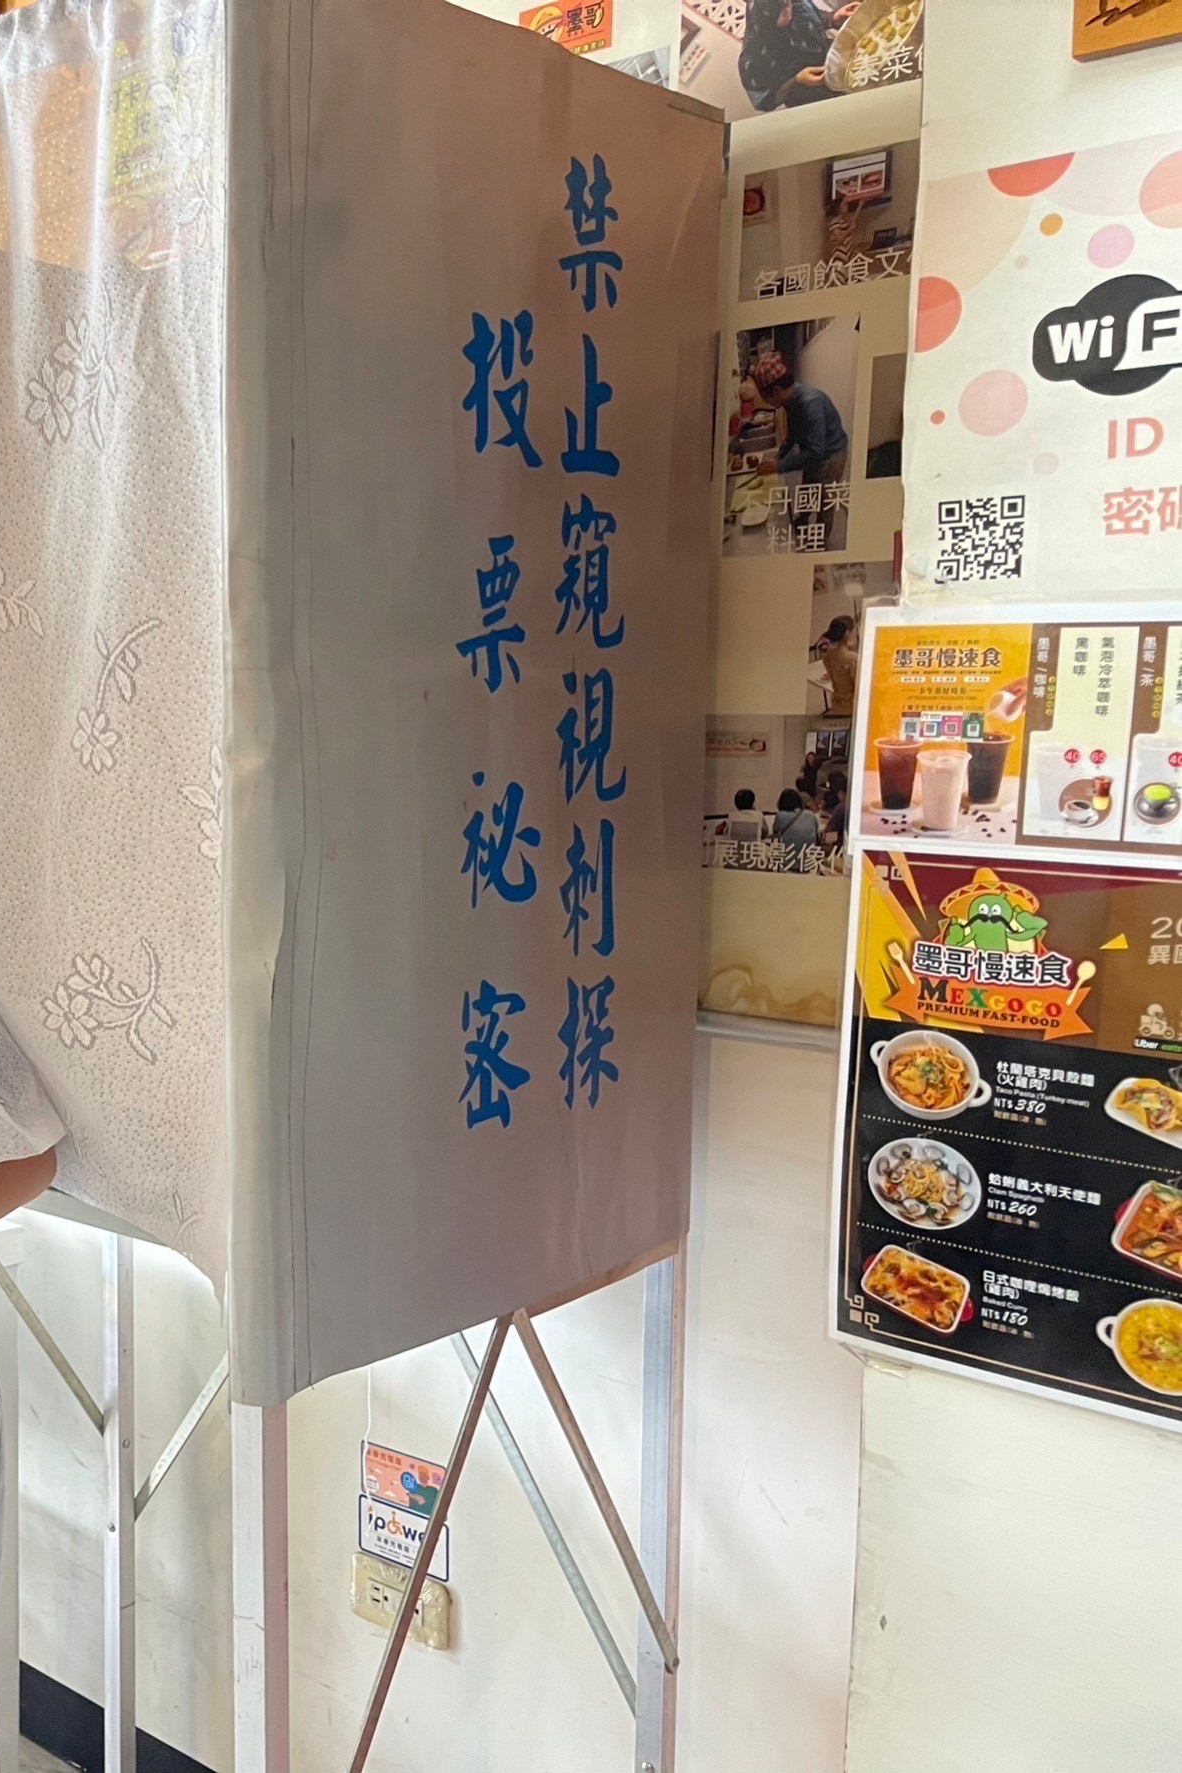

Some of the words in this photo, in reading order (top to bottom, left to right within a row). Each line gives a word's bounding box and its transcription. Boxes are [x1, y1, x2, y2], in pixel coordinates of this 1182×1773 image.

[852, 43, 923, 88] 素菜
[754, 249, 914, 300] 各國飲食文
[1107, 417, 1165, 459] ID
[768, 523, 826, 552] 料理
[556, 154, 625, 1110] 禁止窺視刺探
[893, 647, 1002, 668] 墨哥慢速食
[915, 943, 1068, 984] 墨哥慢速食
[918, 1002, 980, 1018] PREMIUM
[983, 1011, 1060, 1028] FAST-FOOD
[1134, 1038, 1158, 1049] Uber
